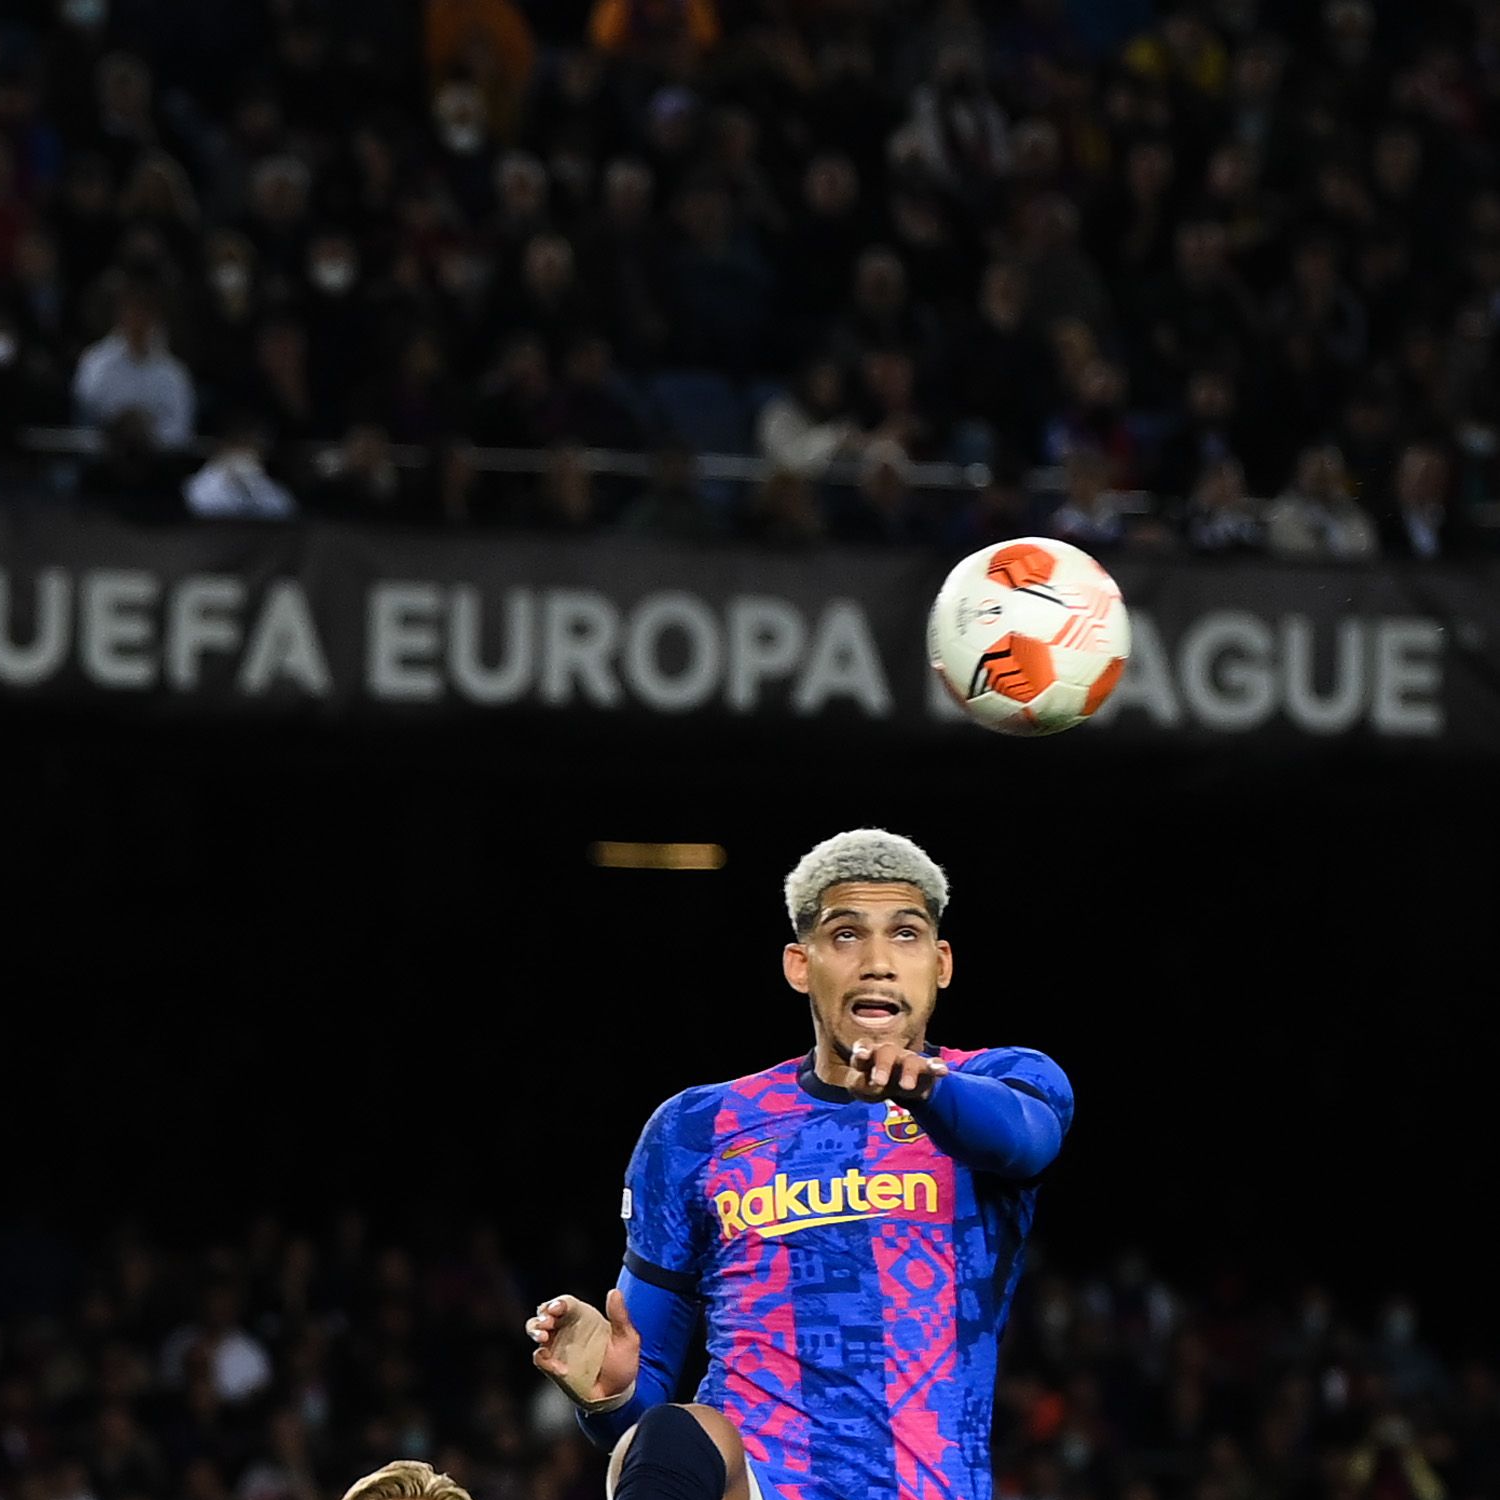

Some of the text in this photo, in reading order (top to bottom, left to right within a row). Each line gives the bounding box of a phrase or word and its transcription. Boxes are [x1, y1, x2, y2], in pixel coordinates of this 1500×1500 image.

[366, 582, 893, 719] EUROPA
[926, 604, 1446, 739] AGUE
[715, 1167, 938, 1239] Rakuten
